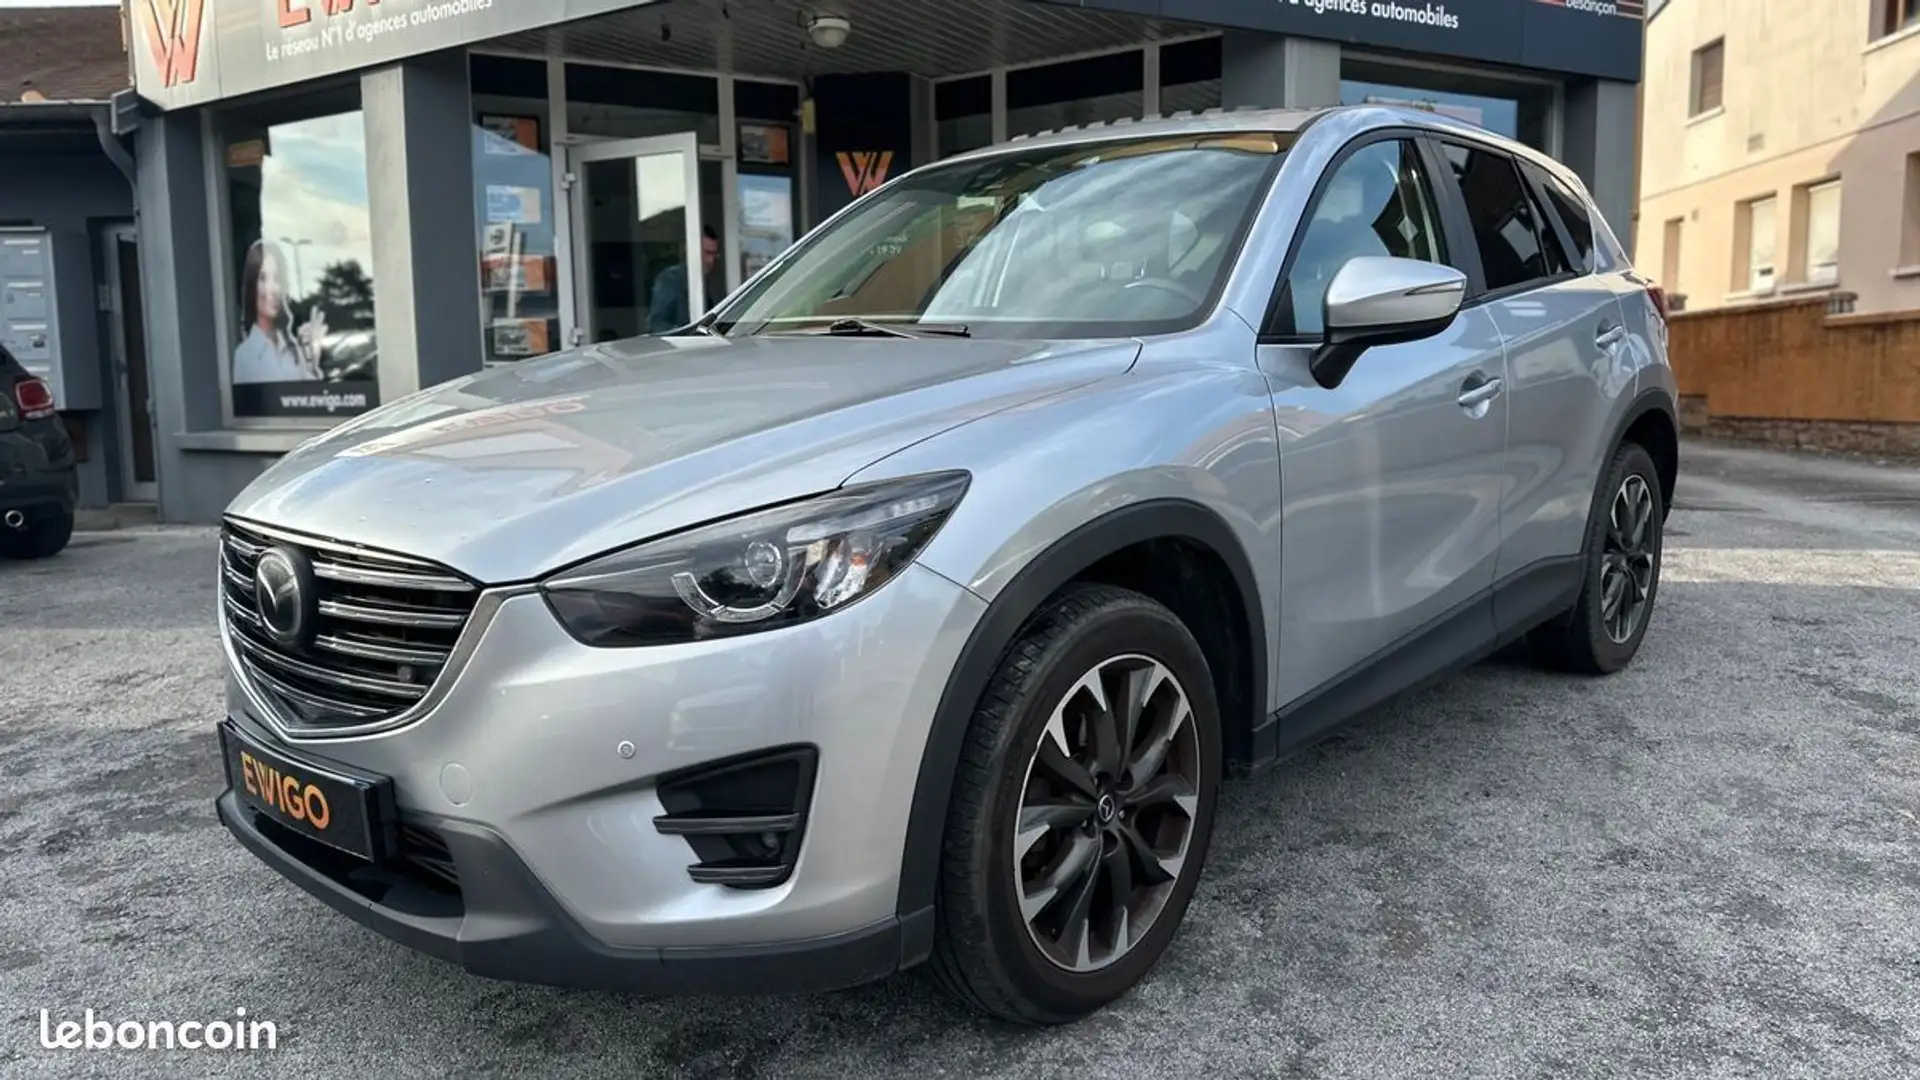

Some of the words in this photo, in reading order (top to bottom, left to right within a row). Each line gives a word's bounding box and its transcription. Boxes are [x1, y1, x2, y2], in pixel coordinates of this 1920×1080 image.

[265, 41, 280, 62] Le
[281, 34, 320, 59] réseau
[345, 14, 407, 43] d'agences
[410, 0, 493, 26] automobiles
[1370, 3, 1459, 29] automobiles
[280, 388, 367, 412] www.ewigo.com
[240, 750, 330, 830] EWIGO
